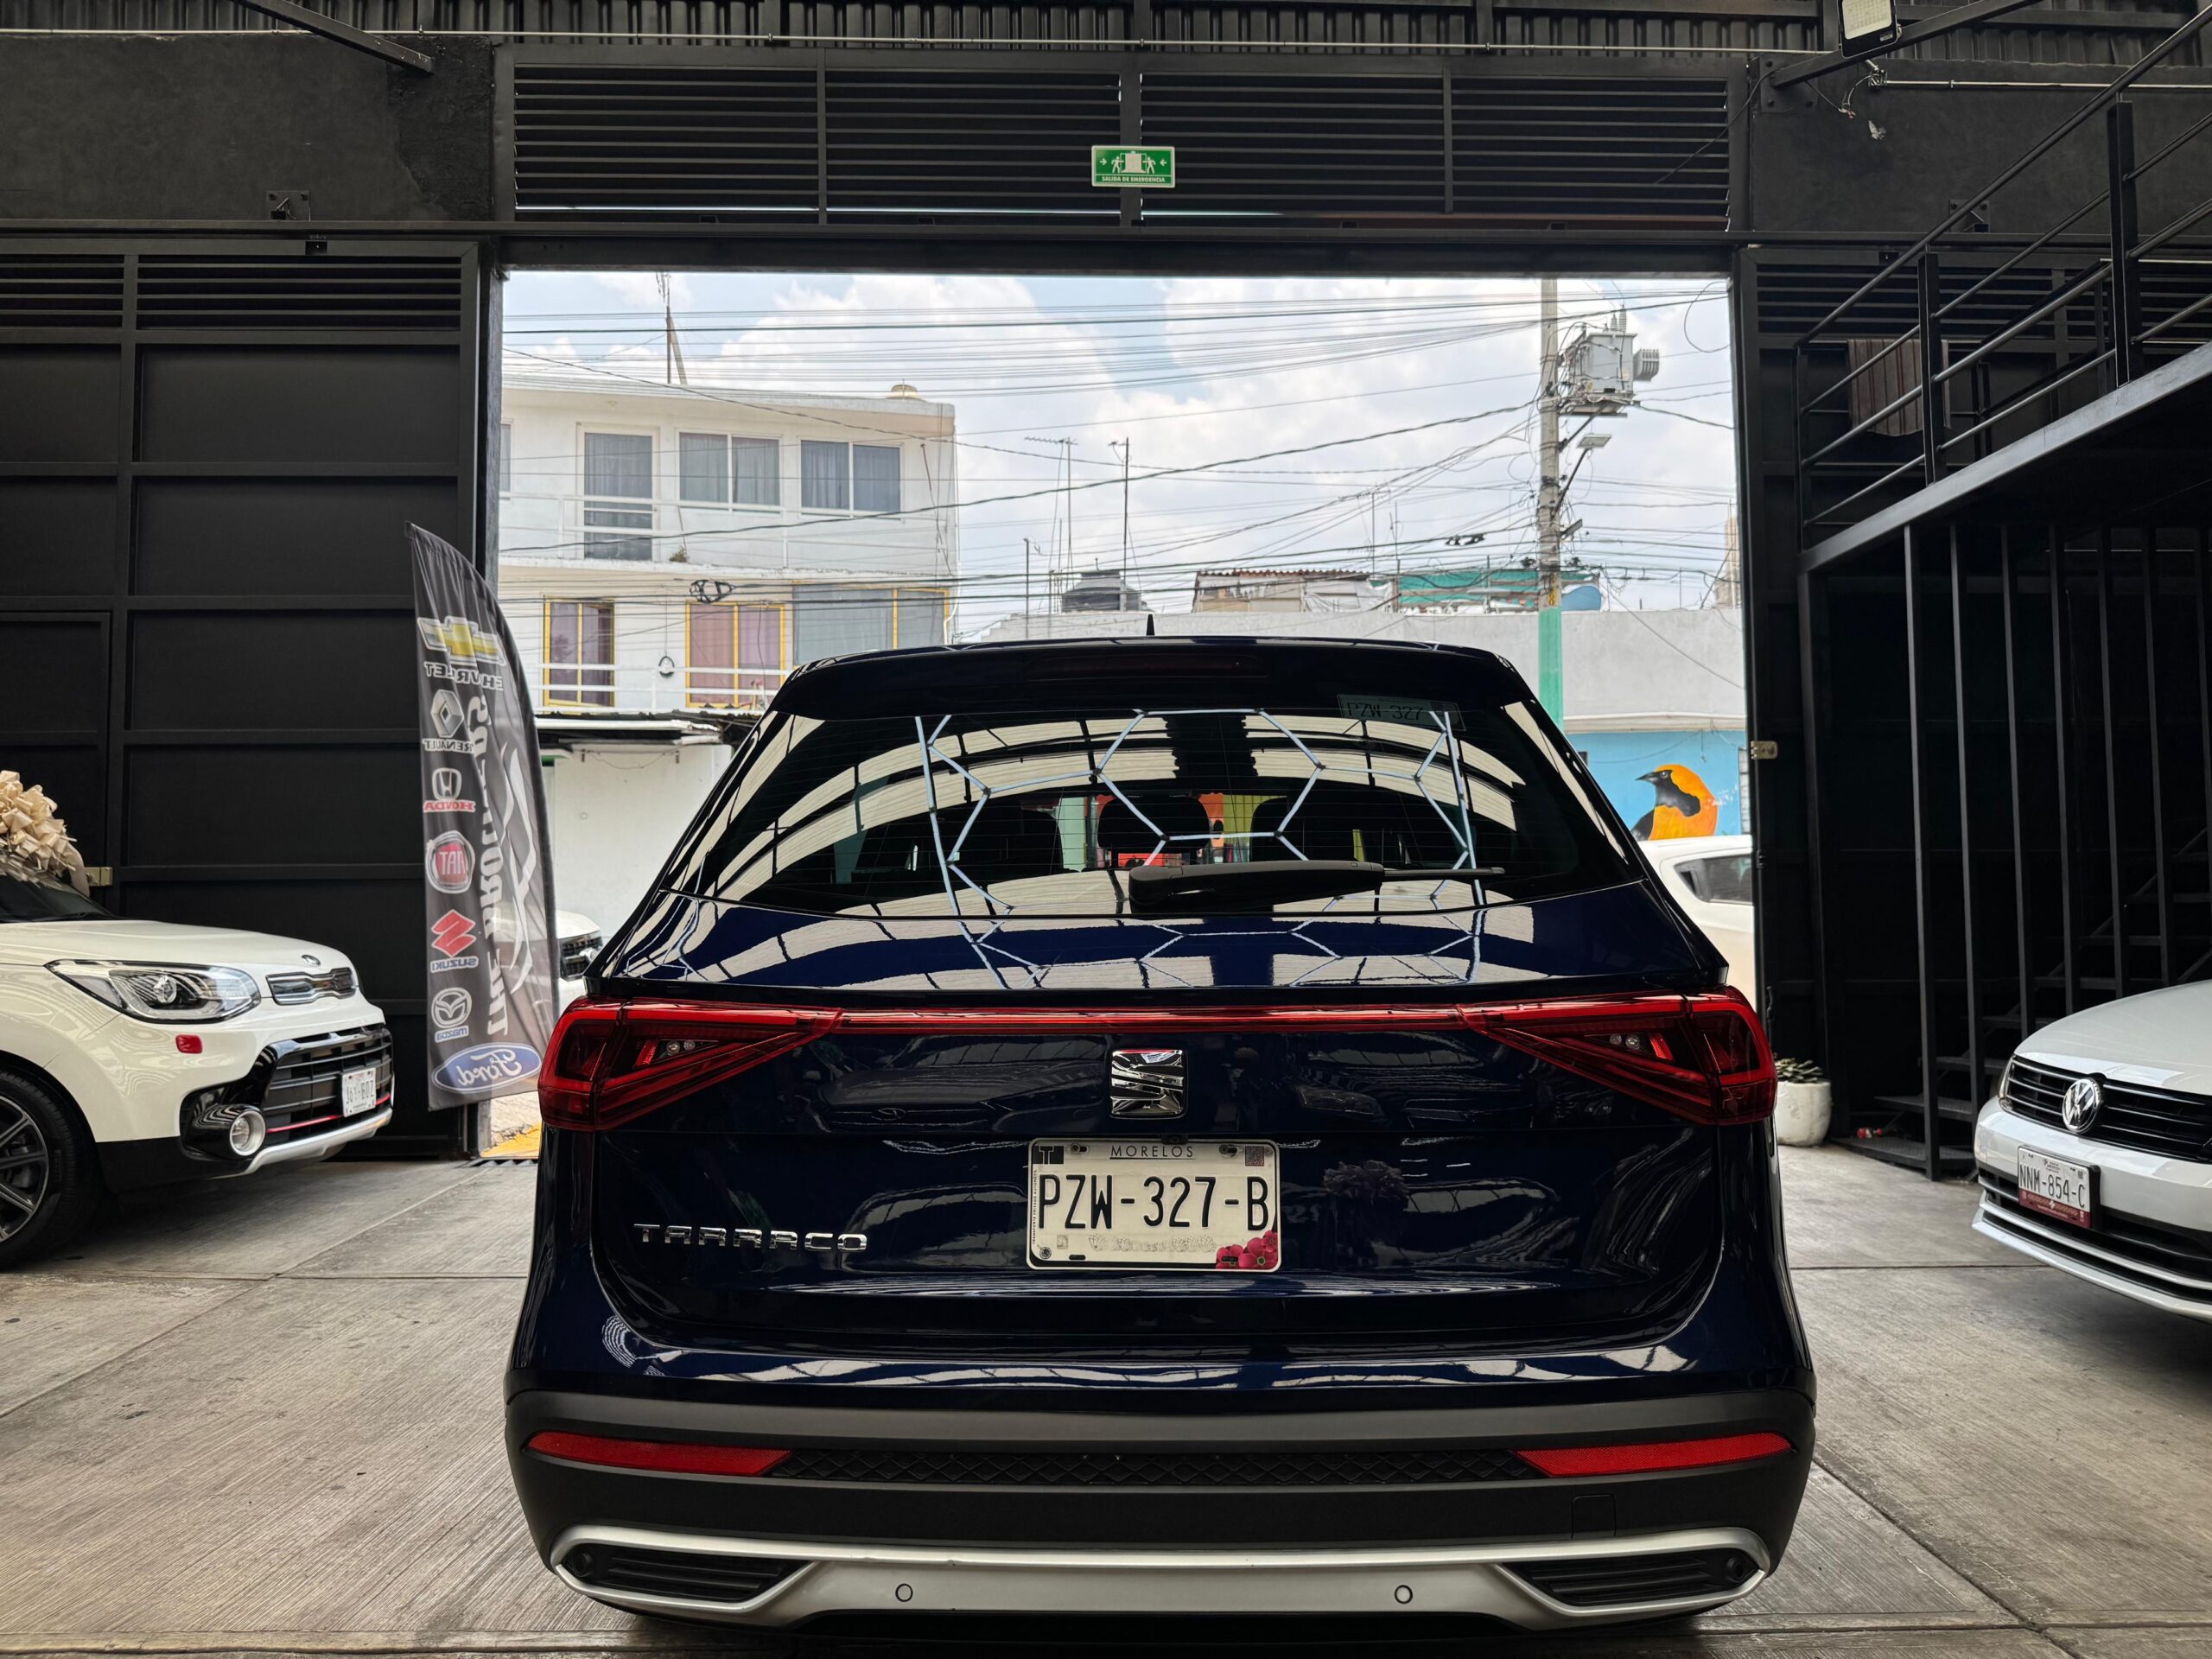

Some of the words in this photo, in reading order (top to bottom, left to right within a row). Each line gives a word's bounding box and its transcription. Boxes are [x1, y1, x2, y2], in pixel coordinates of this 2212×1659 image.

[1110, 1145, 1194, 1158] MORELOS
[1039, 1174, 1269, 1231] PZW-327-B
[2019, 1164, 2086, 1208] NNM-854-C
[633, 1223, 868, 1251] TARRACO
